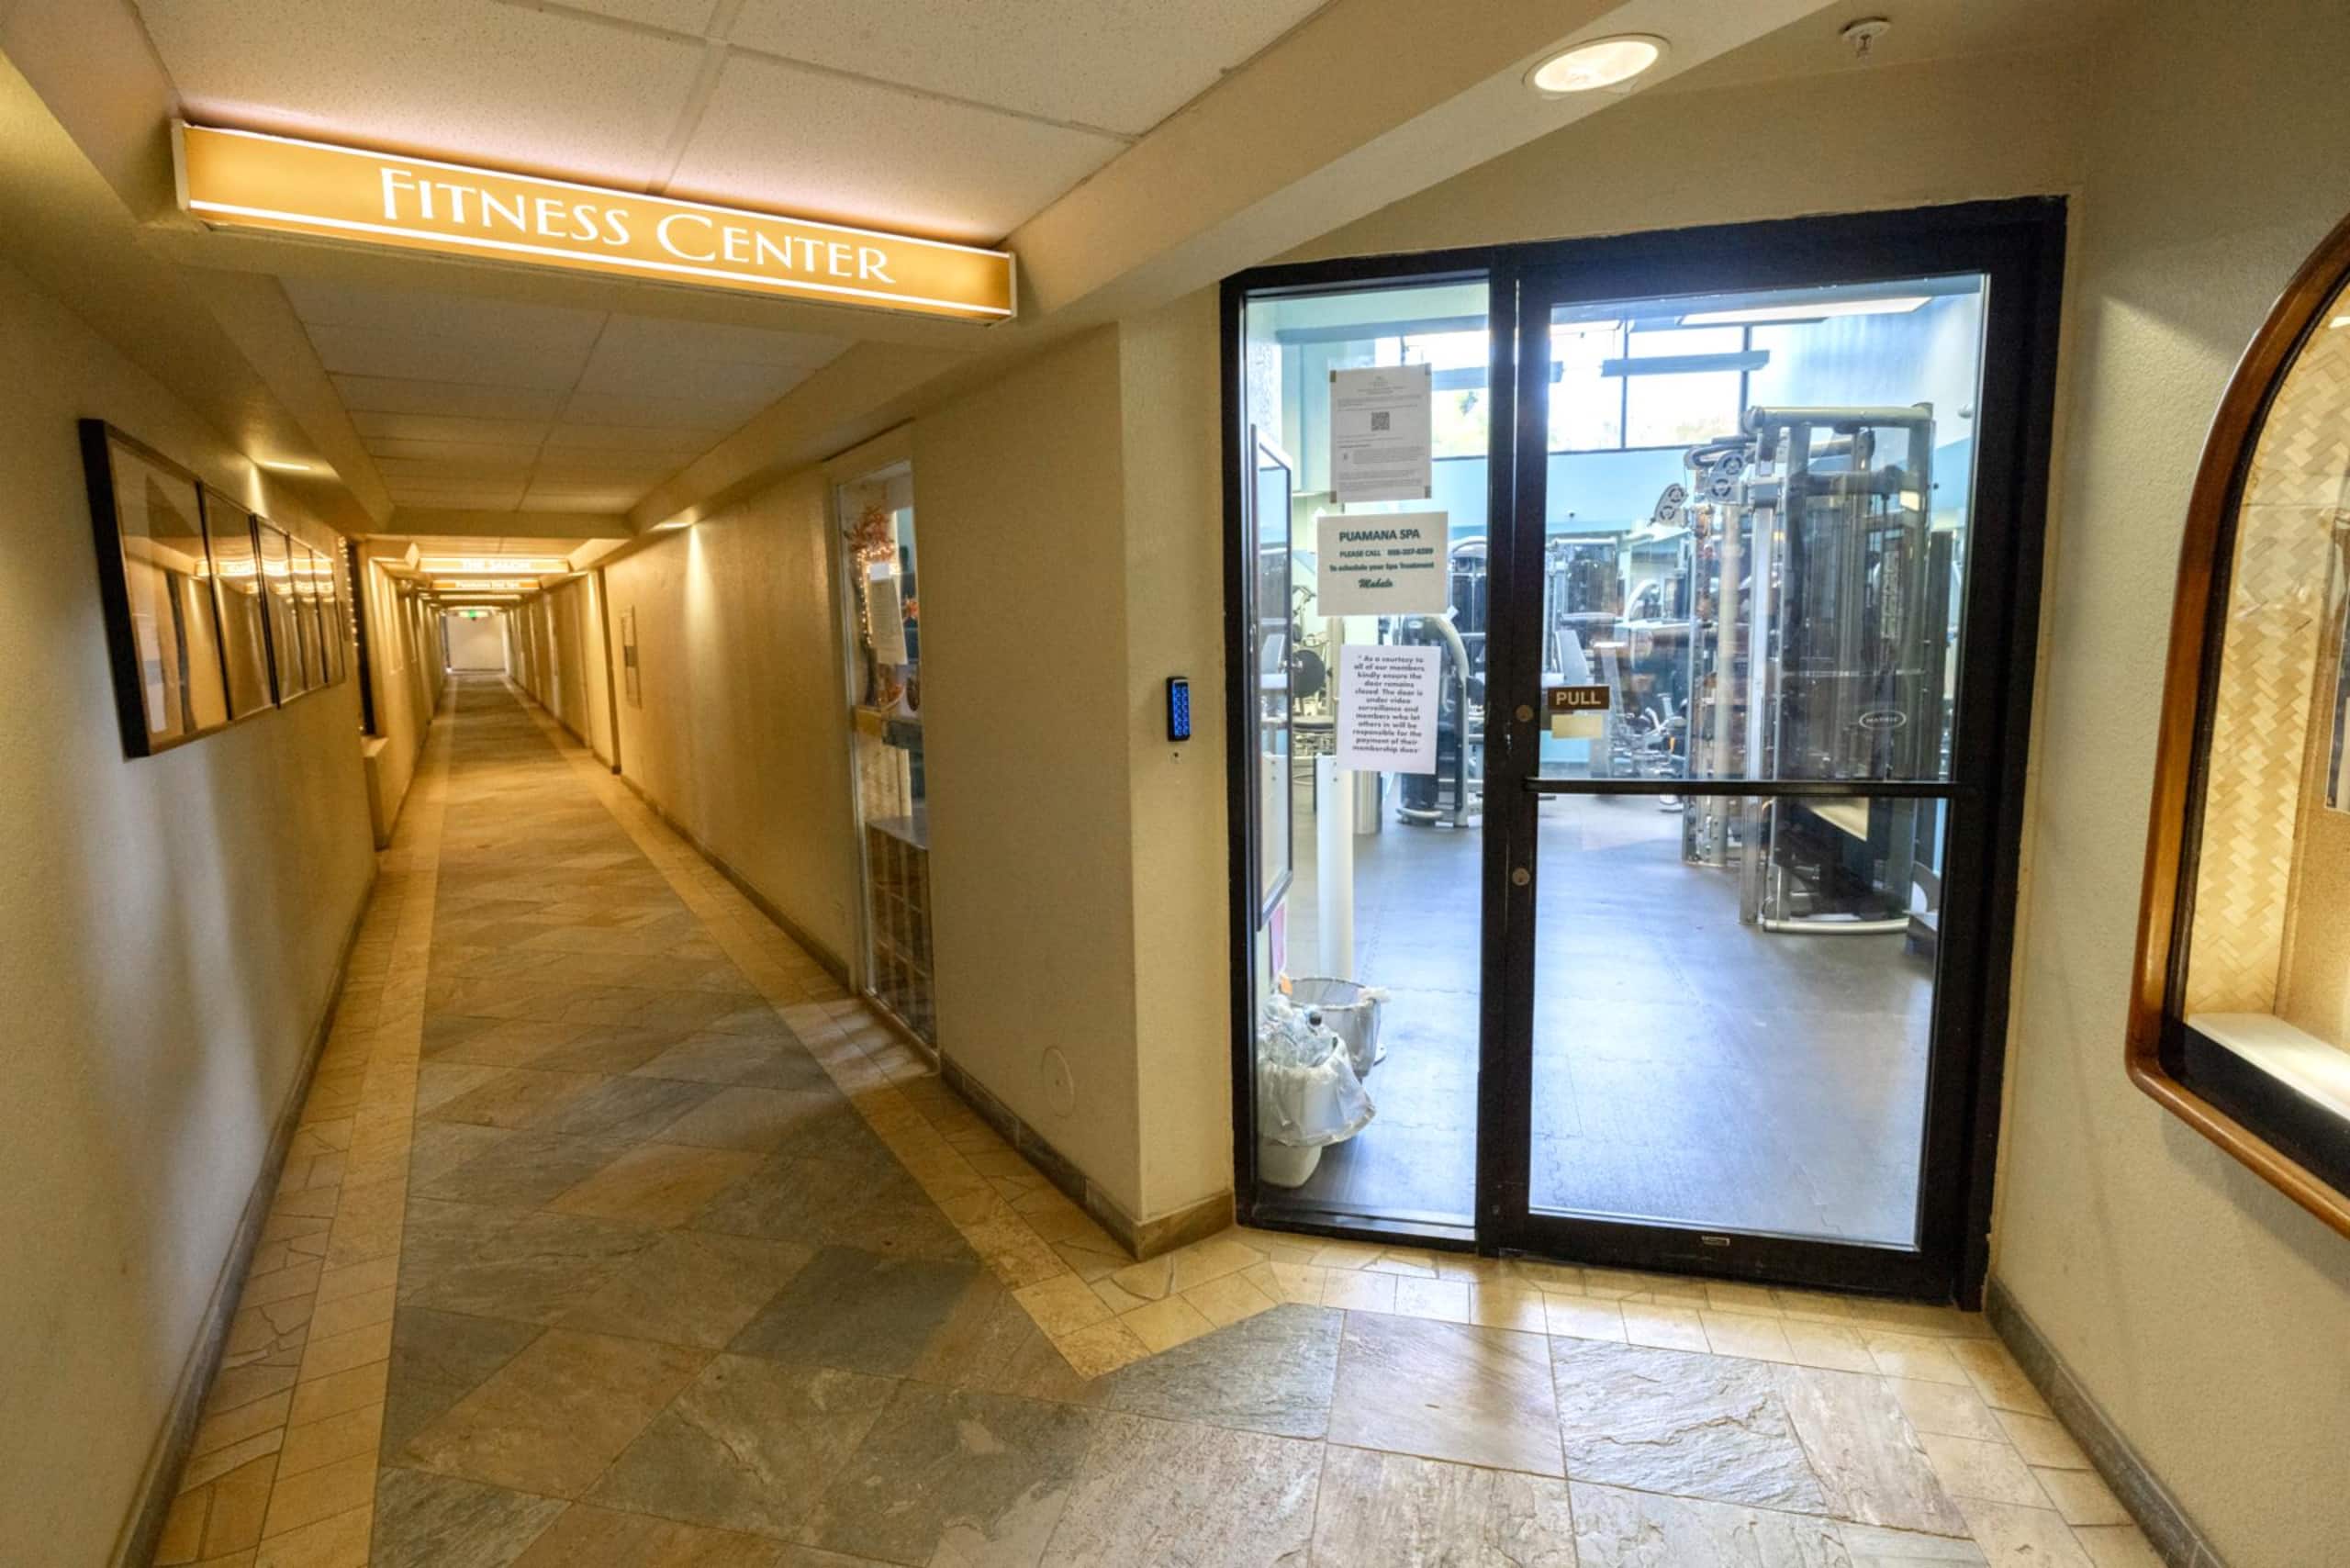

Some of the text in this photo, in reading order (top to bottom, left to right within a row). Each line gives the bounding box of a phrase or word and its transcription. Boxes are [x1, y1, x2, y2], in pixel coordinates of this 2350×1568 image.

[380, 167, 896, 284] FITNESS CENTER
[1338, 529, 1421, 542] PUAMANA SPA
[1339, 549, 1364, 558] PLEASE
[1365, 549, 1382, 557] CALL
[1382, 655, 1414, 664] courtesy
[1389, 664, 1425, 672] members
[1358, 671, 1380, 679] kindly
[1555, 690, 1602, 706] PULL
[1396, 729, 1407, 737] for
[1351, 745, 1398, 754] membership
